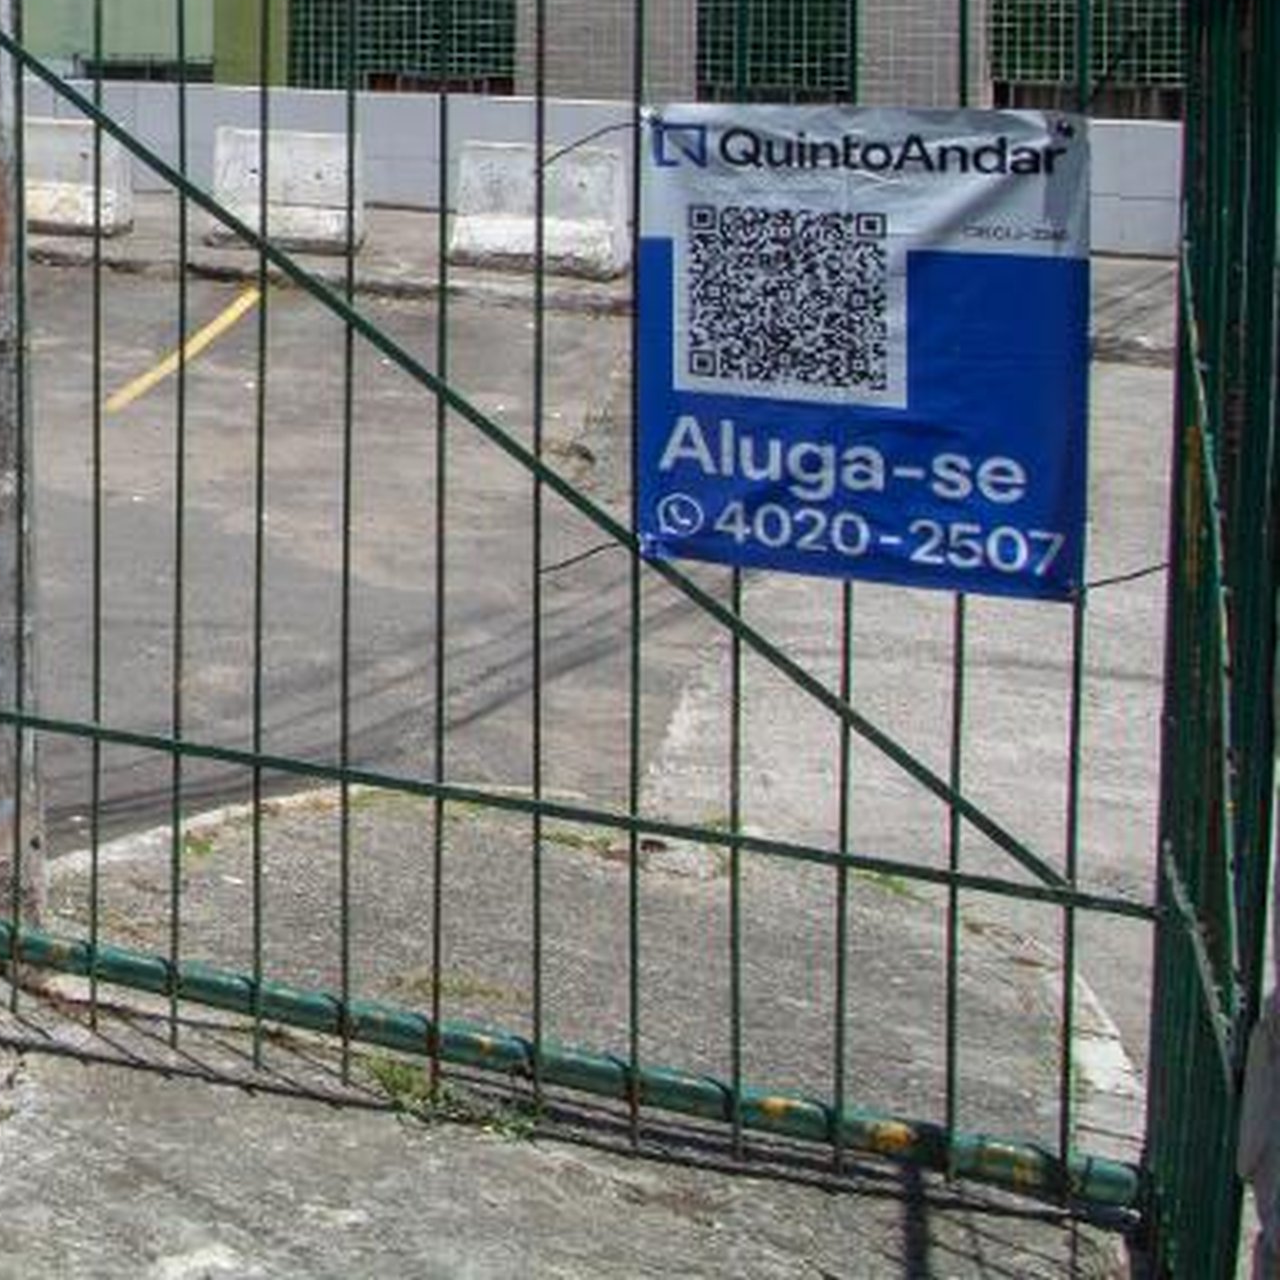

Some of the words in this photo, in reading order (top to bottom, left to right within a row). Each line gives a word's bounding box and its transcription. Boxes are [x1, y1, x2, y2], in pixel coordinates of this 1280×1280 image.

[719, 127, 1067, 175] QuintoAndar
[658, 415, 1027, 503] Aluga-se
[714, 501, 1066, 577] 4020-2507
